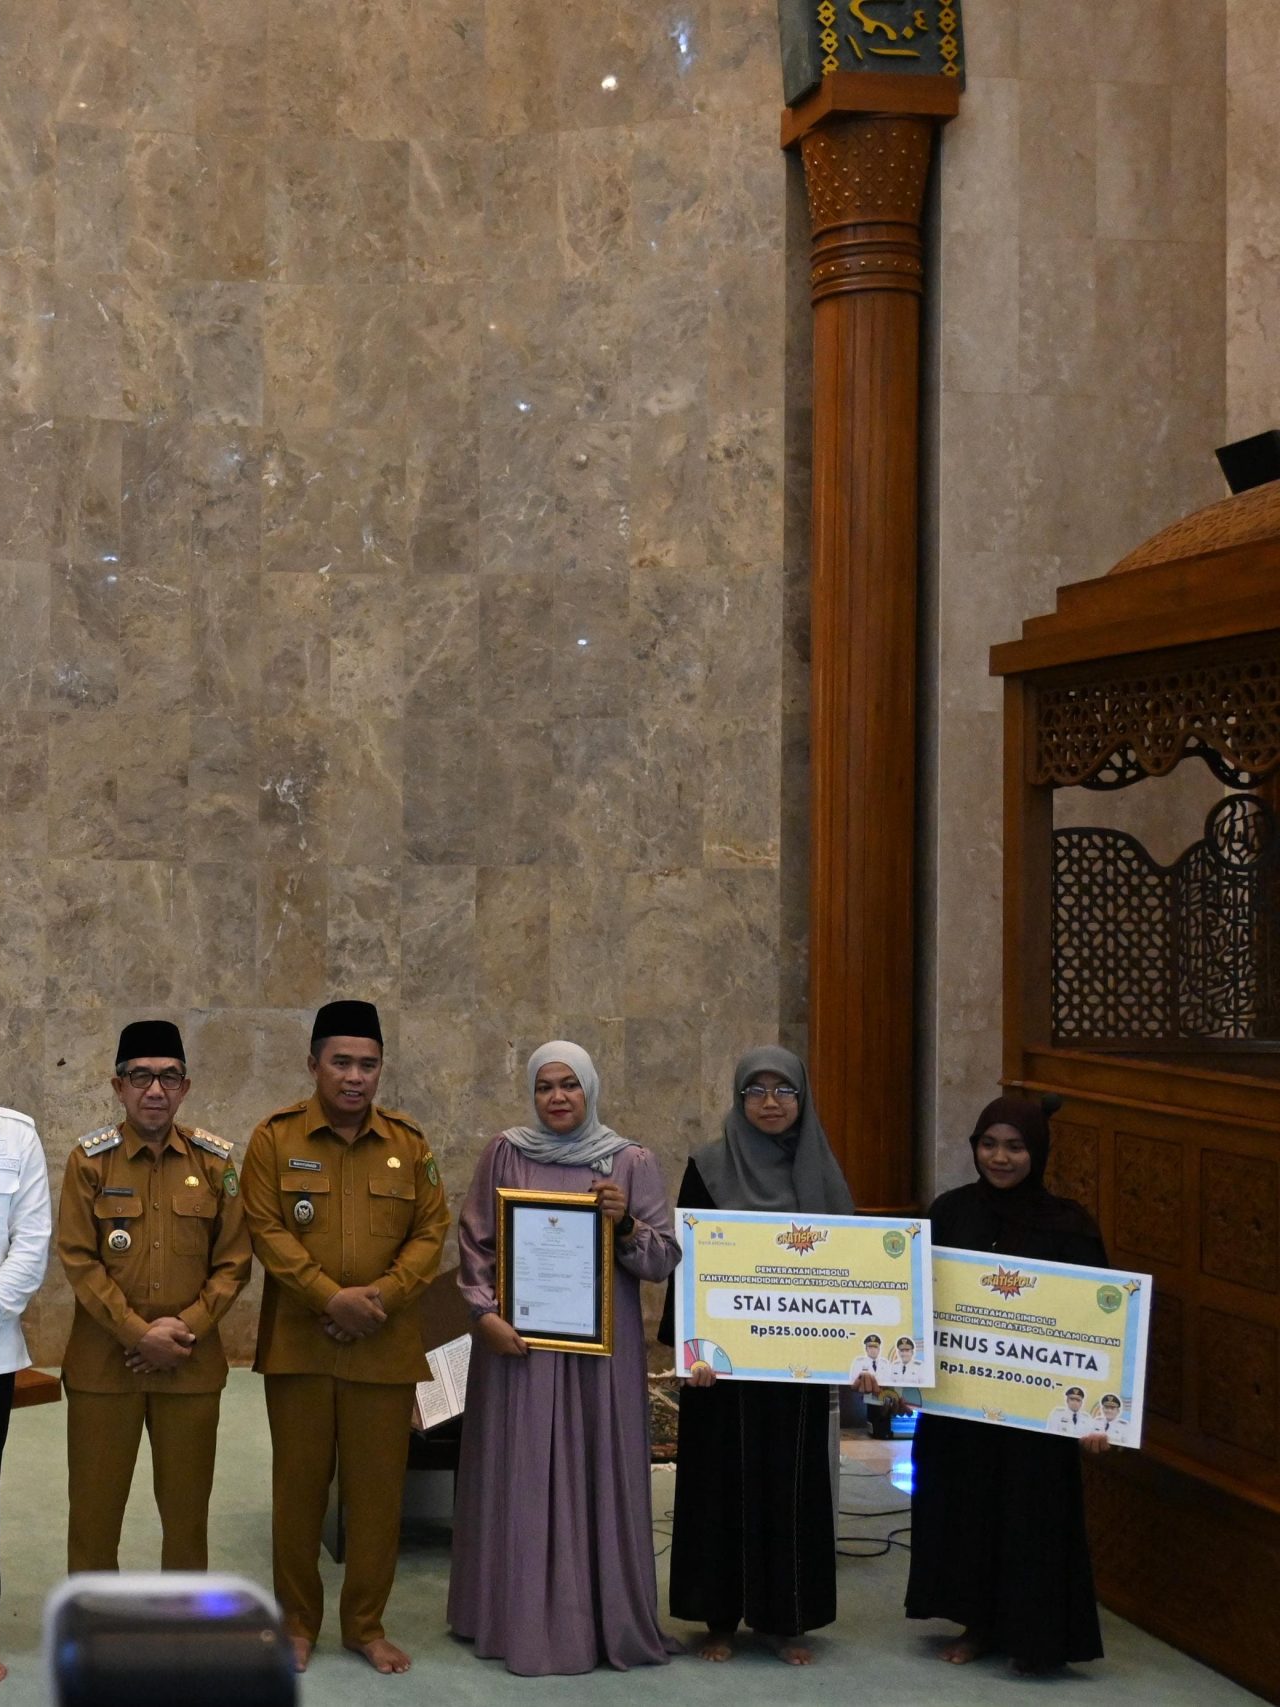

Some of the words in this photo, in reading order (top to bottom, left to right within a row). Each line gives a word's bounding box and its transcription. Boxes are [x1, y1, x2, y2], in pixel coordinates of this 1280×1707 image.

[755, 1265, 811, 1275] PENYERAHAN
[811, 1268, 849, 1277] SIMBOLIS
[700, 1275, 740, 1284] BANTUAN
[740, 1276, 792, 1286] PENDIDIKAN
[792, 1279, 839, 1288] GRATISPOL
[840, 1280, 872, 1289] DALAM
[873, 1281, 908, 1290] DAERAH
[733, 1295, 771, 1312] STAI
[778, 1297, 873, 1316] SANGATTA
[956, 1304, 1015, 1321] PENYERAHAN
[1015, 1313, 1056, 1326] SIMBOLIS
[751, 1325, 856, 1340] Rp525.000.000,-
[939, 1312, 993, 1328] PENDIDIKAN
[994, 1320, 1045, 1336] GRATISPOL
[1045, 1328, 1080, 1341] DALAM
[1082, 1333, 1120, 1347] DAERAH
[995, 1340, 1098, 1372] SANGATTA
[940, 1360, 1063, 1389] Rp1.852.200.000,-
